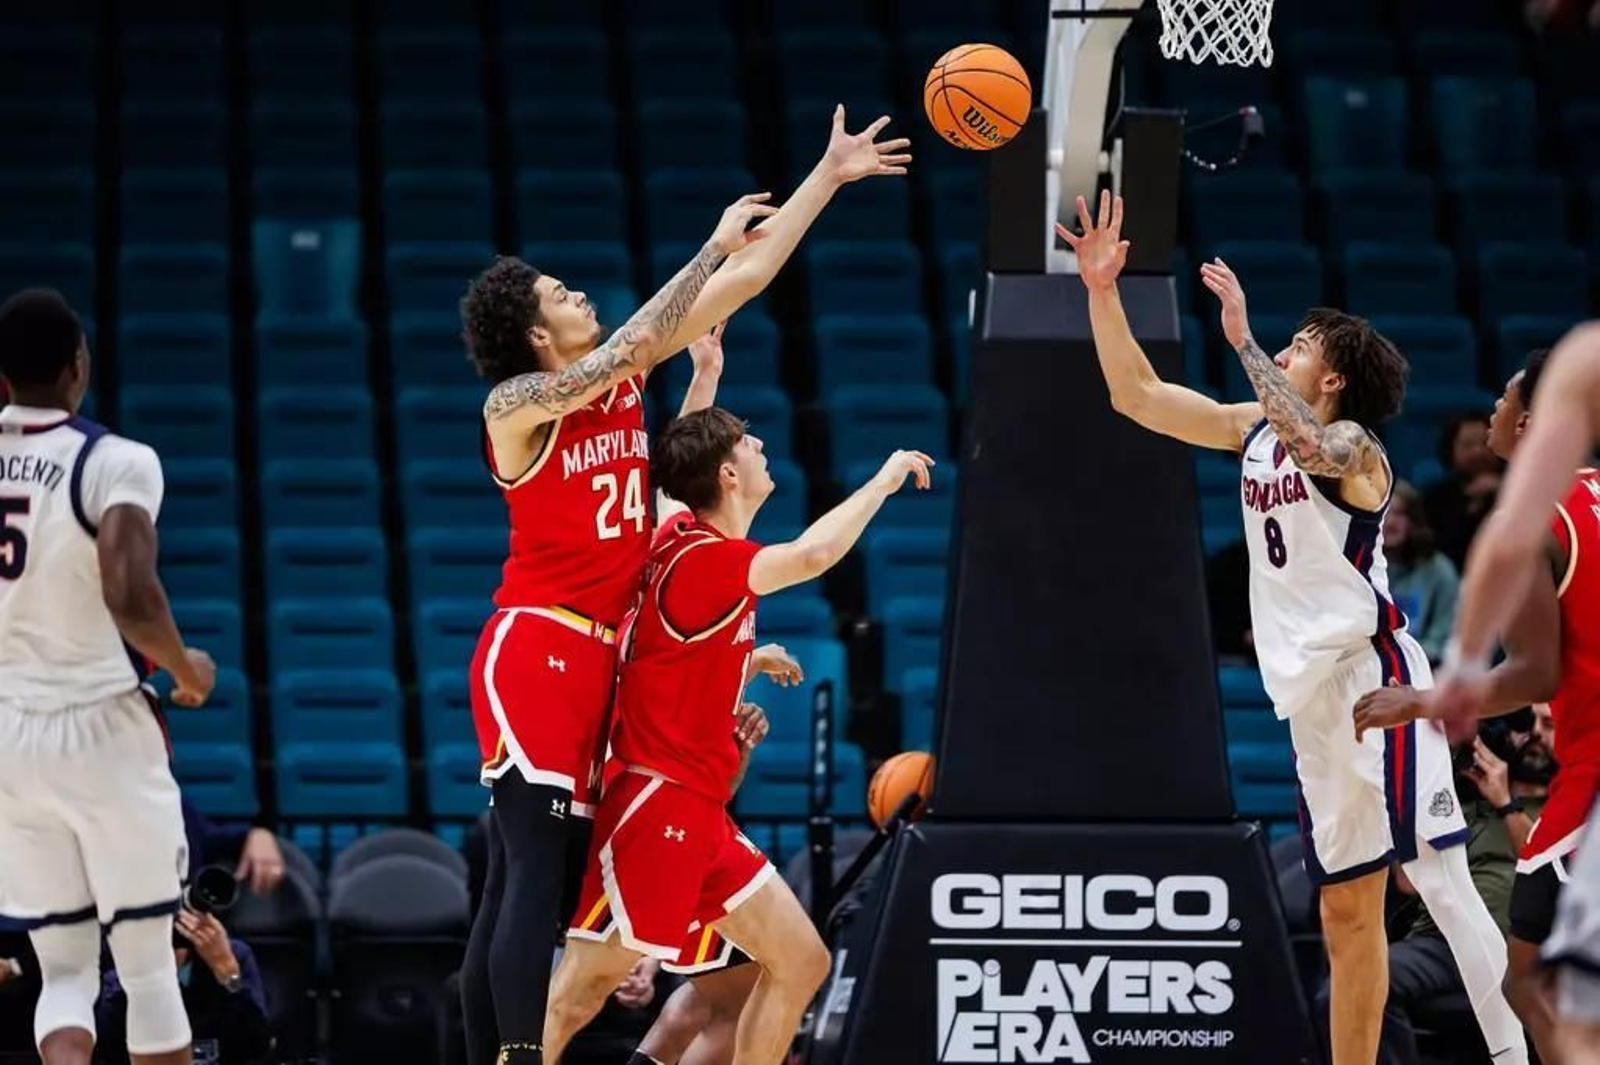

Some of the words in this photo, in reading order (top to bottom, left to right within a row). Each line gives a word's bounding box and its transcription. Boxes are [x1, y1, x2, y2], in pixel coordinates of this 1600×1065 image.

[592, 468, 647, 541] 24
[1242, 471, 1309, 513] GONZAGA
[0, 495, 31, 581] 5
[1264, 516, 1287, 569] 8
[930, 873, 1230, 931] GEICO
[937, 955, 1235, 1015] PLAYERS
[941, 1012, 1091, 1063] ERA
[1092, 1029, 1236, 1048] CHAMPIONSHIP
